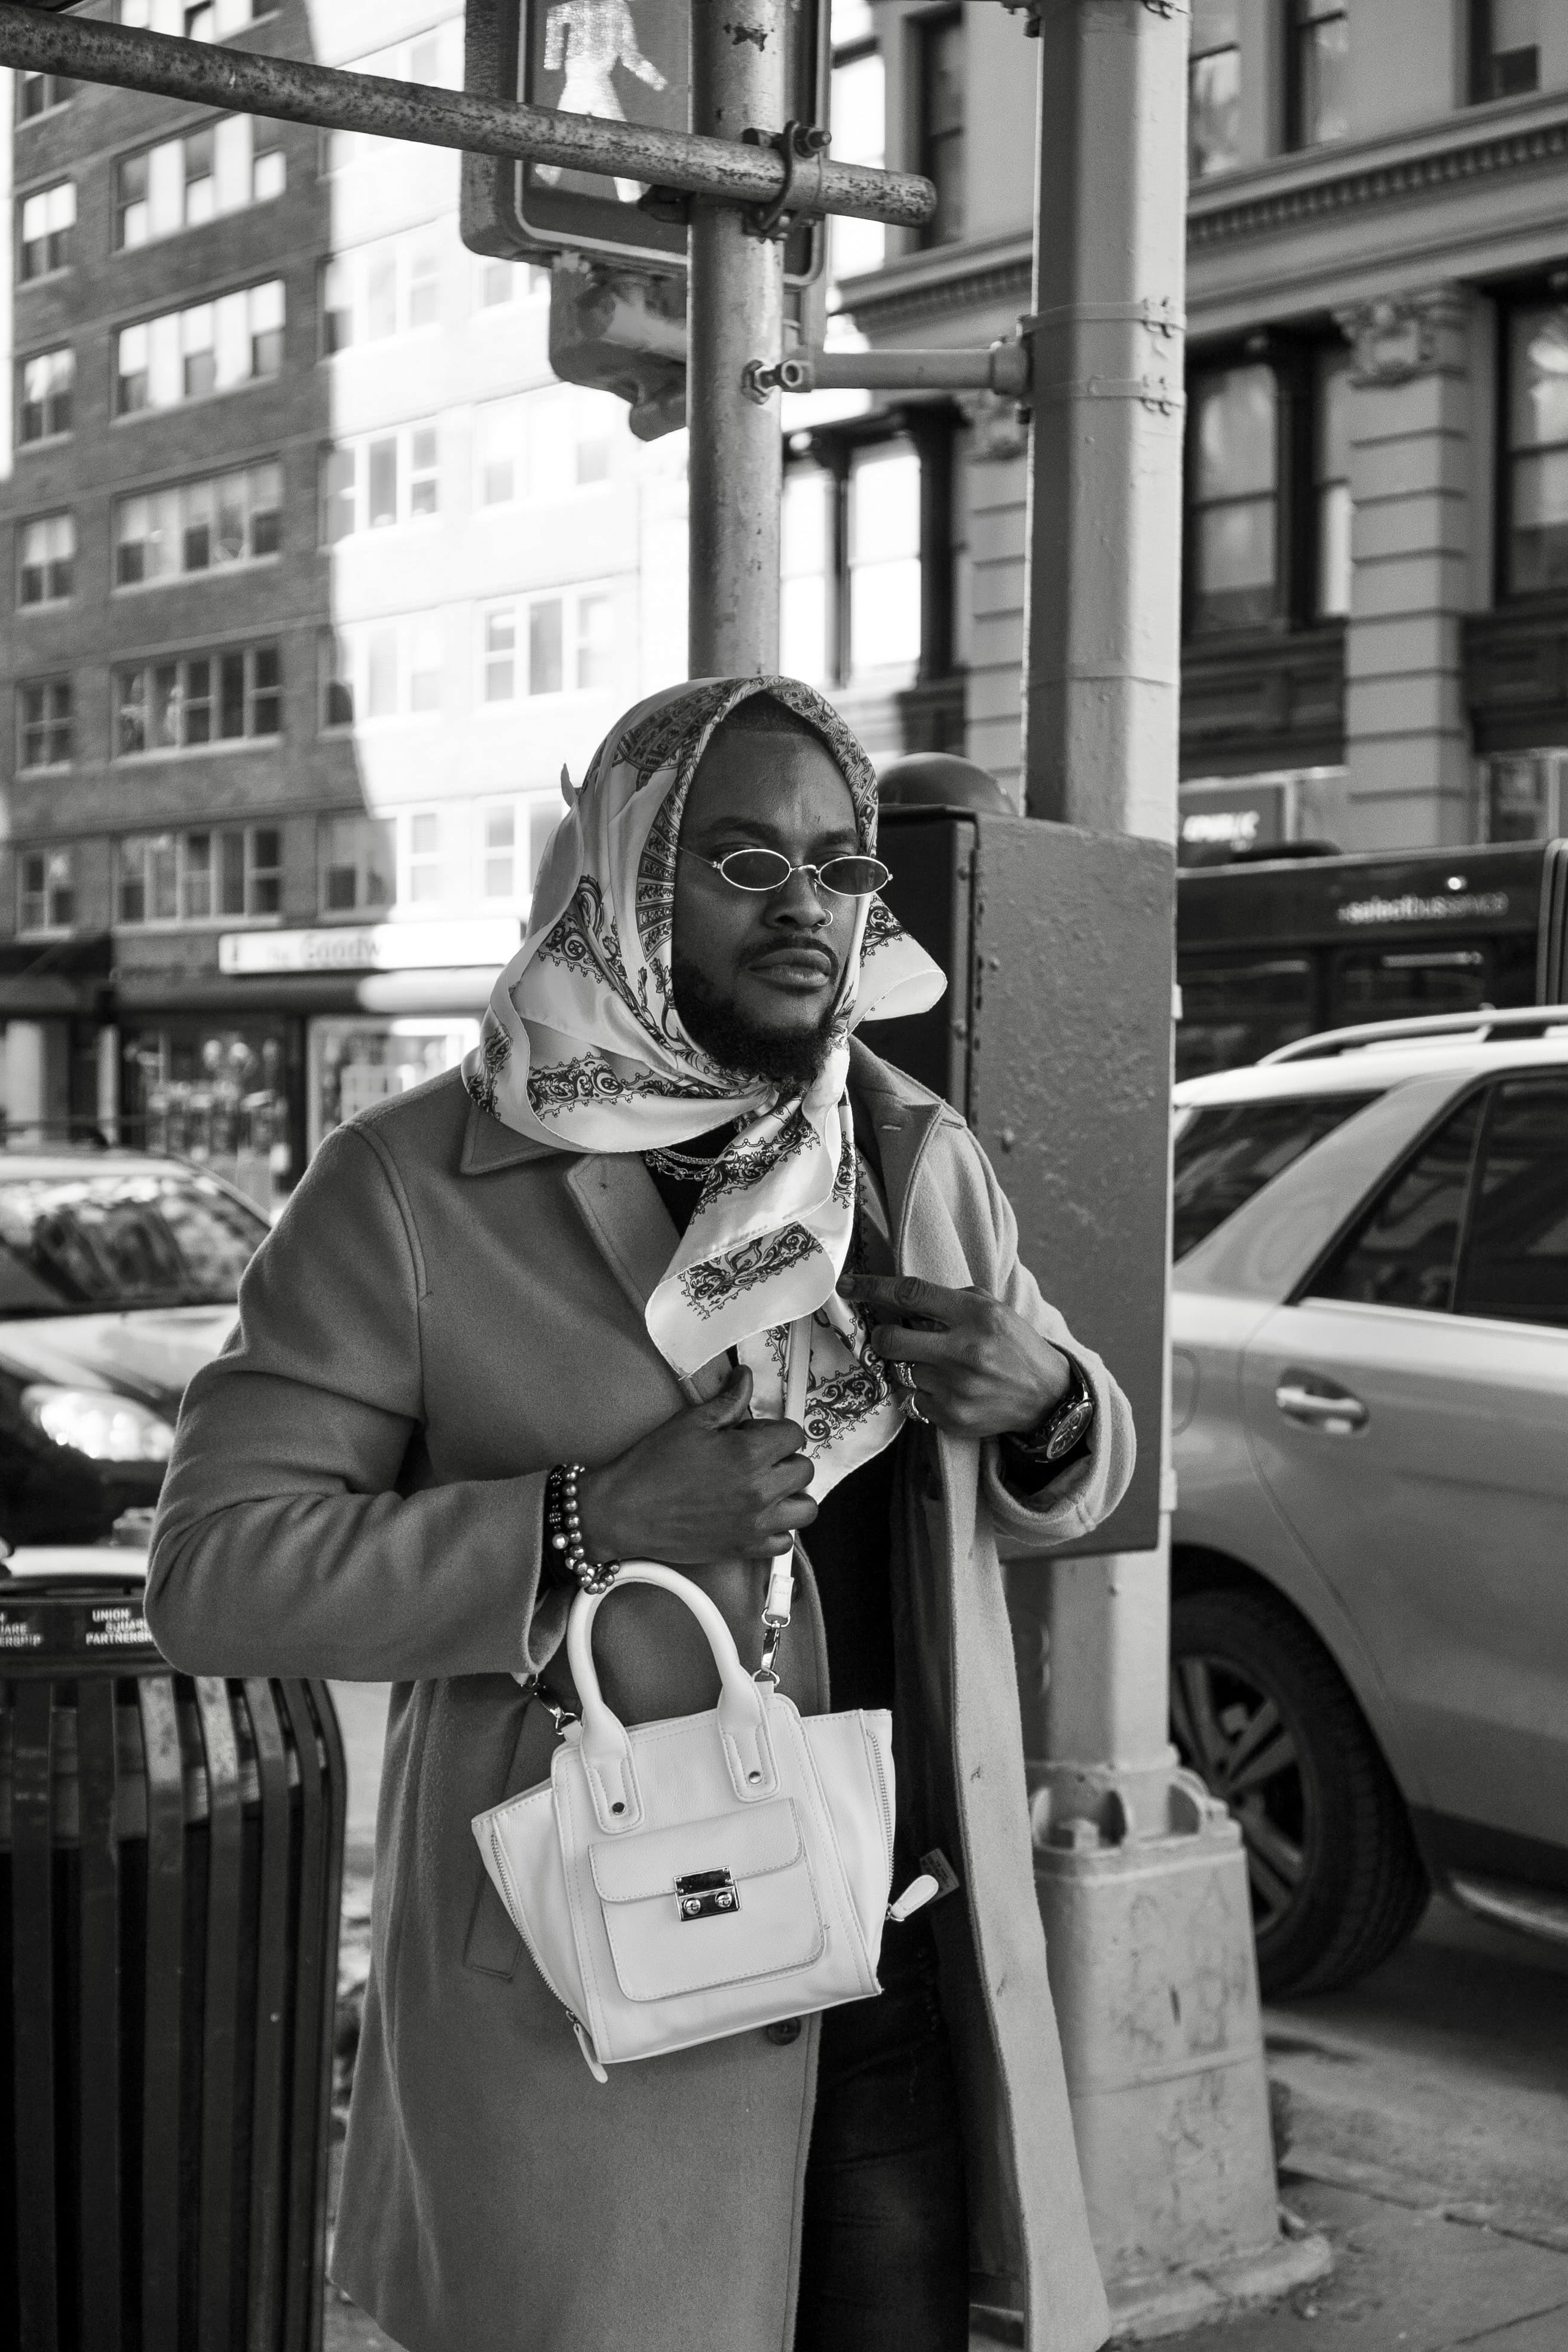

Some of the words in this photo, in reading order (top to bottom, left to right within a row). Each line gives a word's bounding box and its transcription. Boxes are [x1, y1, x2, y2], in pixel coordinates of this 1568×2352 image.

[92, 1608, 130, 1622] UNION
[105, 1618, 148, 1633] SQUAR
[85, 1631, 154, 1645] PARTNERSH
